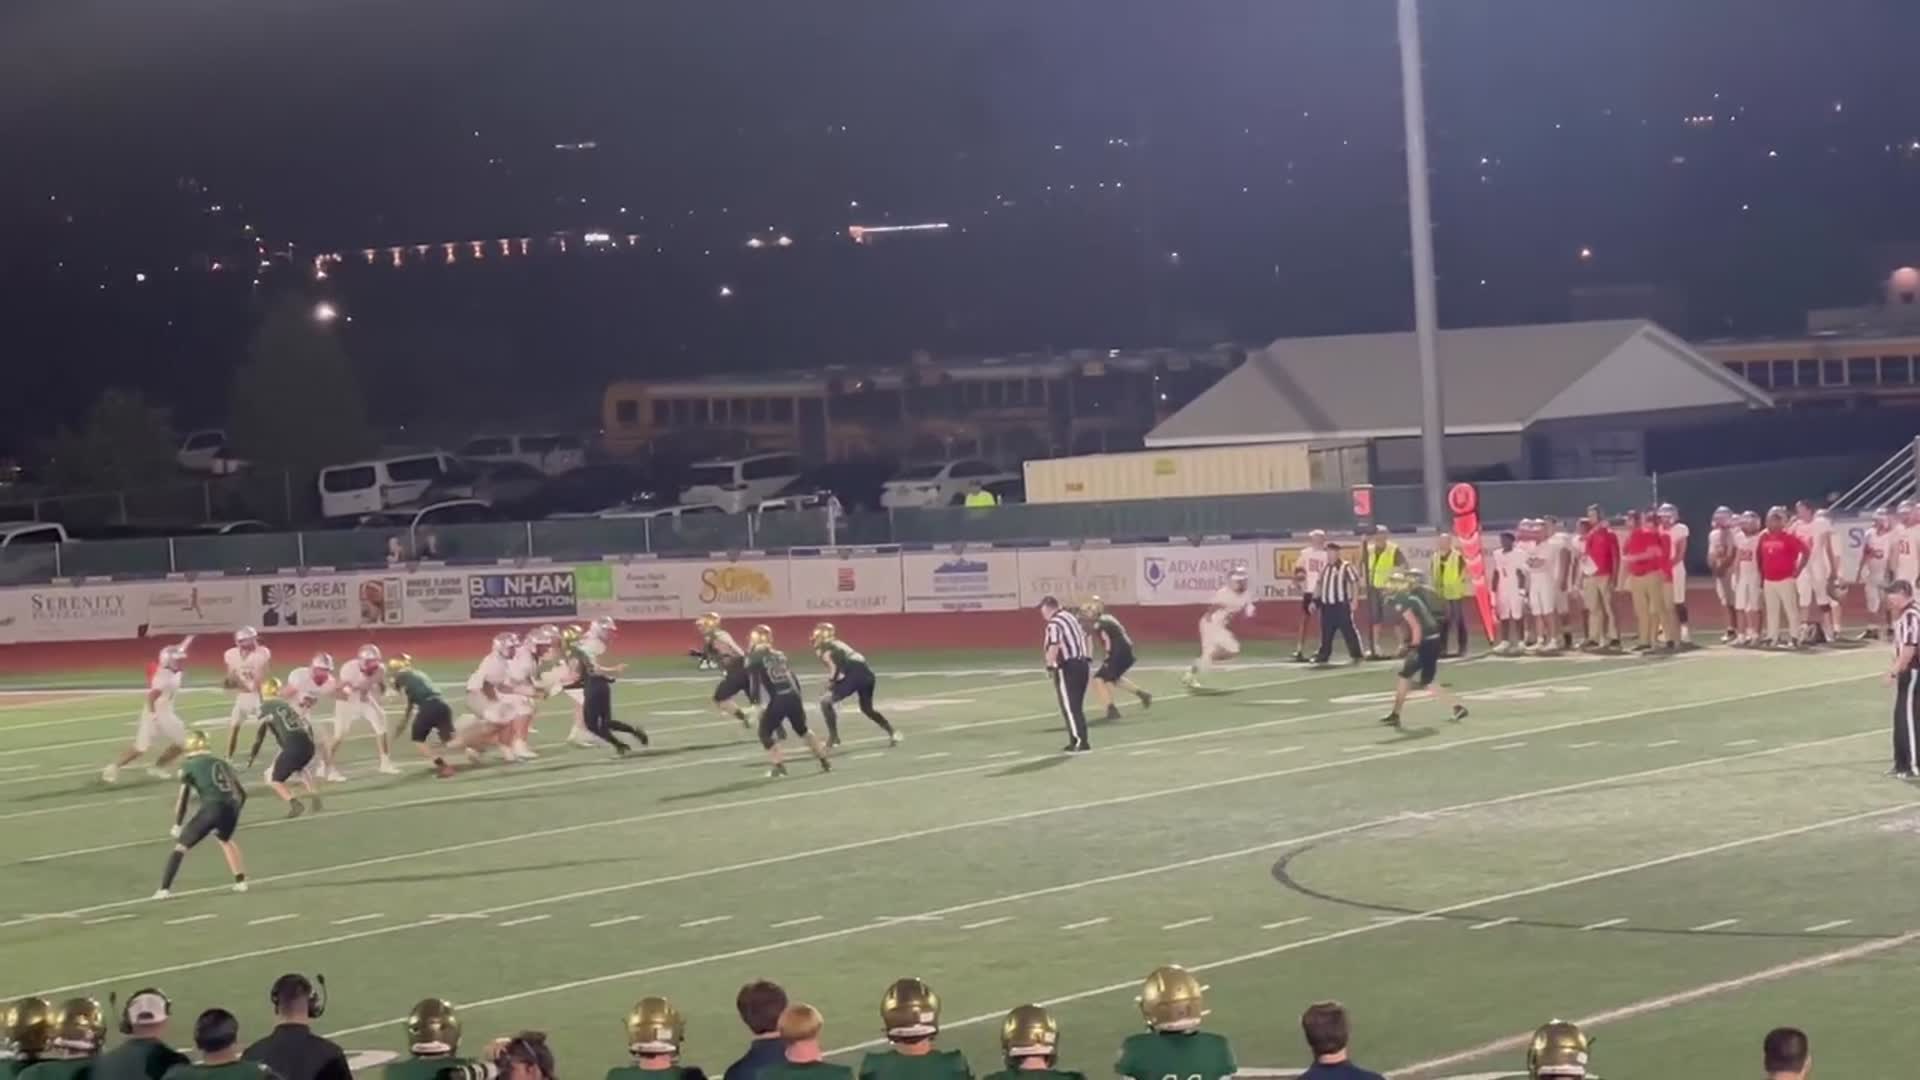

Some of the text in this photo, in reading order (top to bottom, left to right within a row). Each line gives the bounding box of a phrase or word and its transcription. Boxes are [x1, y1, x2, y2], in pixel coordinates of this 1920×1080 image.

[300, 583, 347, 598] GREAT
[470, 575, 573, 596] BONHAM
[31, 593, 126, 610] SERENITY
[302, 598, 348, 610] HARVEST
[470, 595, 576, 609] CONSTRUCTION
